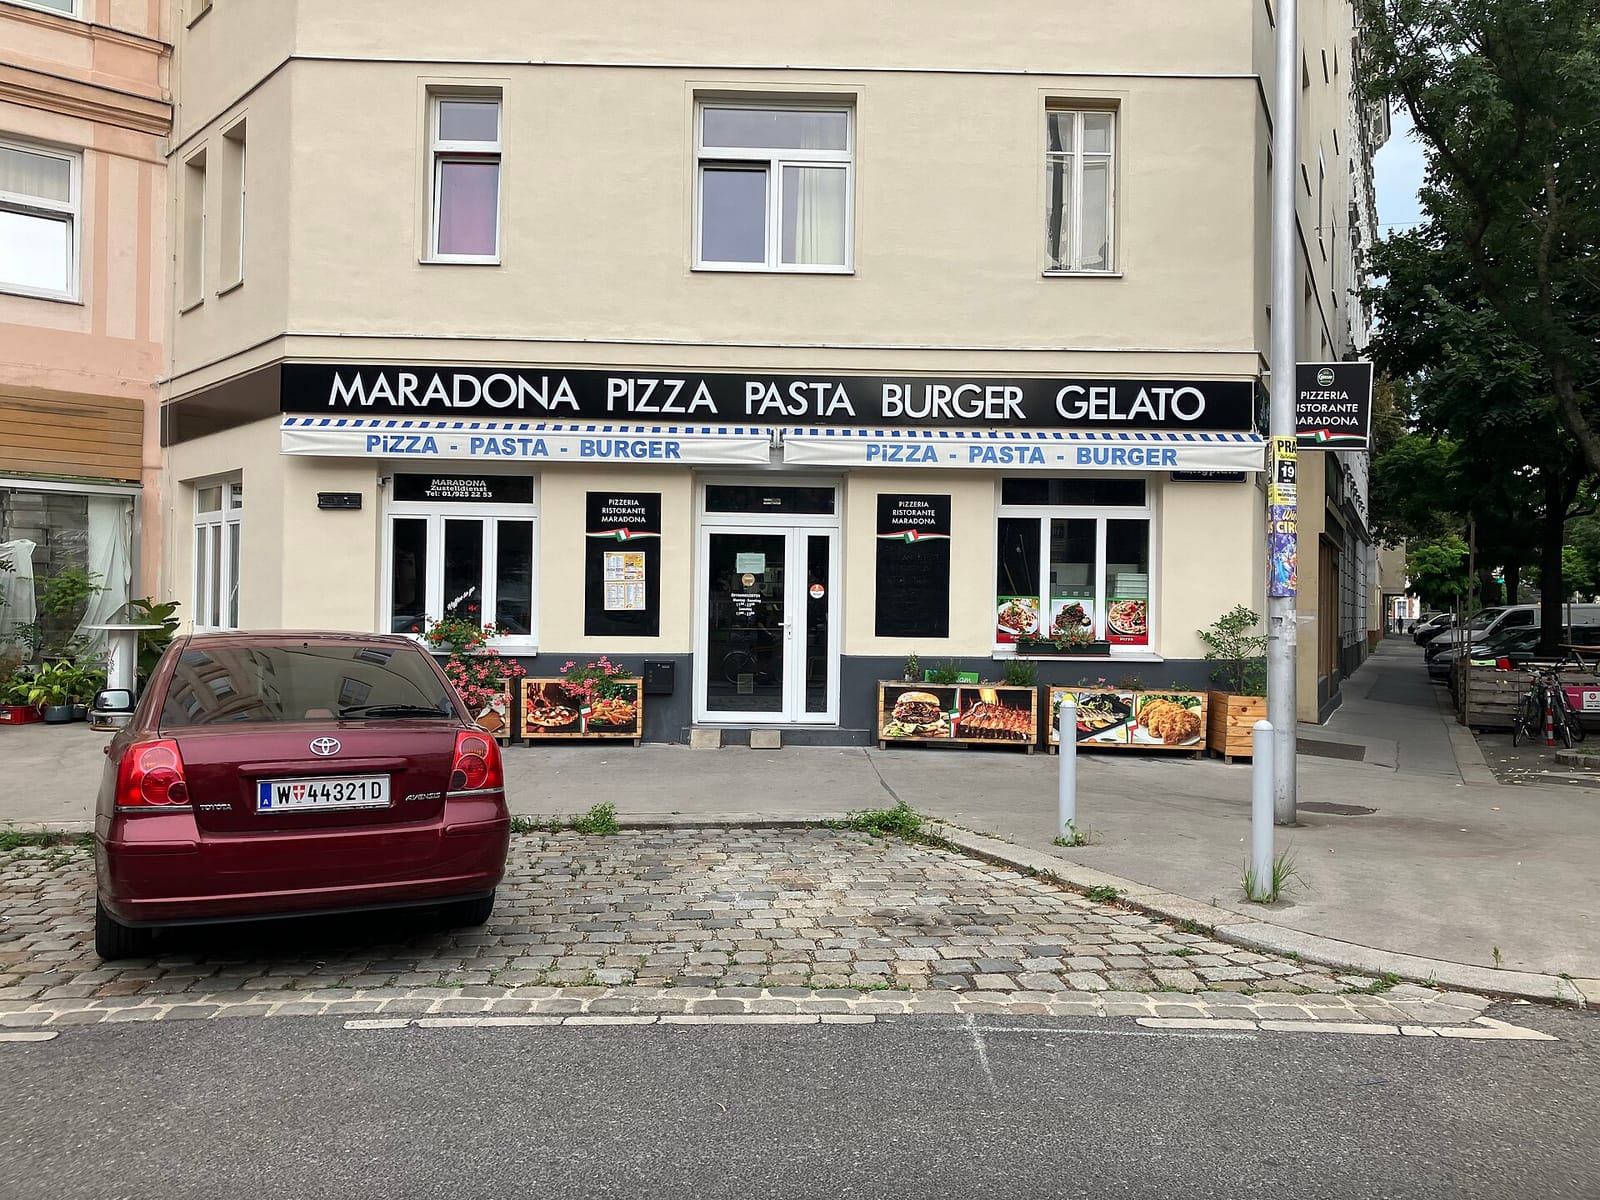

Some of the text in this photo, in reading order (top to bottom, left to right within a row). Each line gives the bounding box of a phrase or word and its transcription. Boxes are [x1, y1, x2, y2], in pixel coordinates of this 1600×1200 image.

[328, 371, 1206, 421] MARADONA PIZZA PASTA BURGER GELATO
[1301, 391, 1349, 400] PIZZERIA
[1297, 403, 1359, 413] ISTORANTE
[470, 437, 548, 456] PASTA
[580, 440, 681, 459] BURGER
[968, 446, 1045, 464] PASTA
[1076, 448, 1178, 466] BURGER
[1281, 466, 1295, 478] 19
[601, 507, 646, 515] RISTORANTE
[892, 509, 936, 517] RISTORANTE
[601, 516, 647, 524] MARADONA
[277, 785, 291, 805] W
[199, 803, 233, 811] TOYOTA
